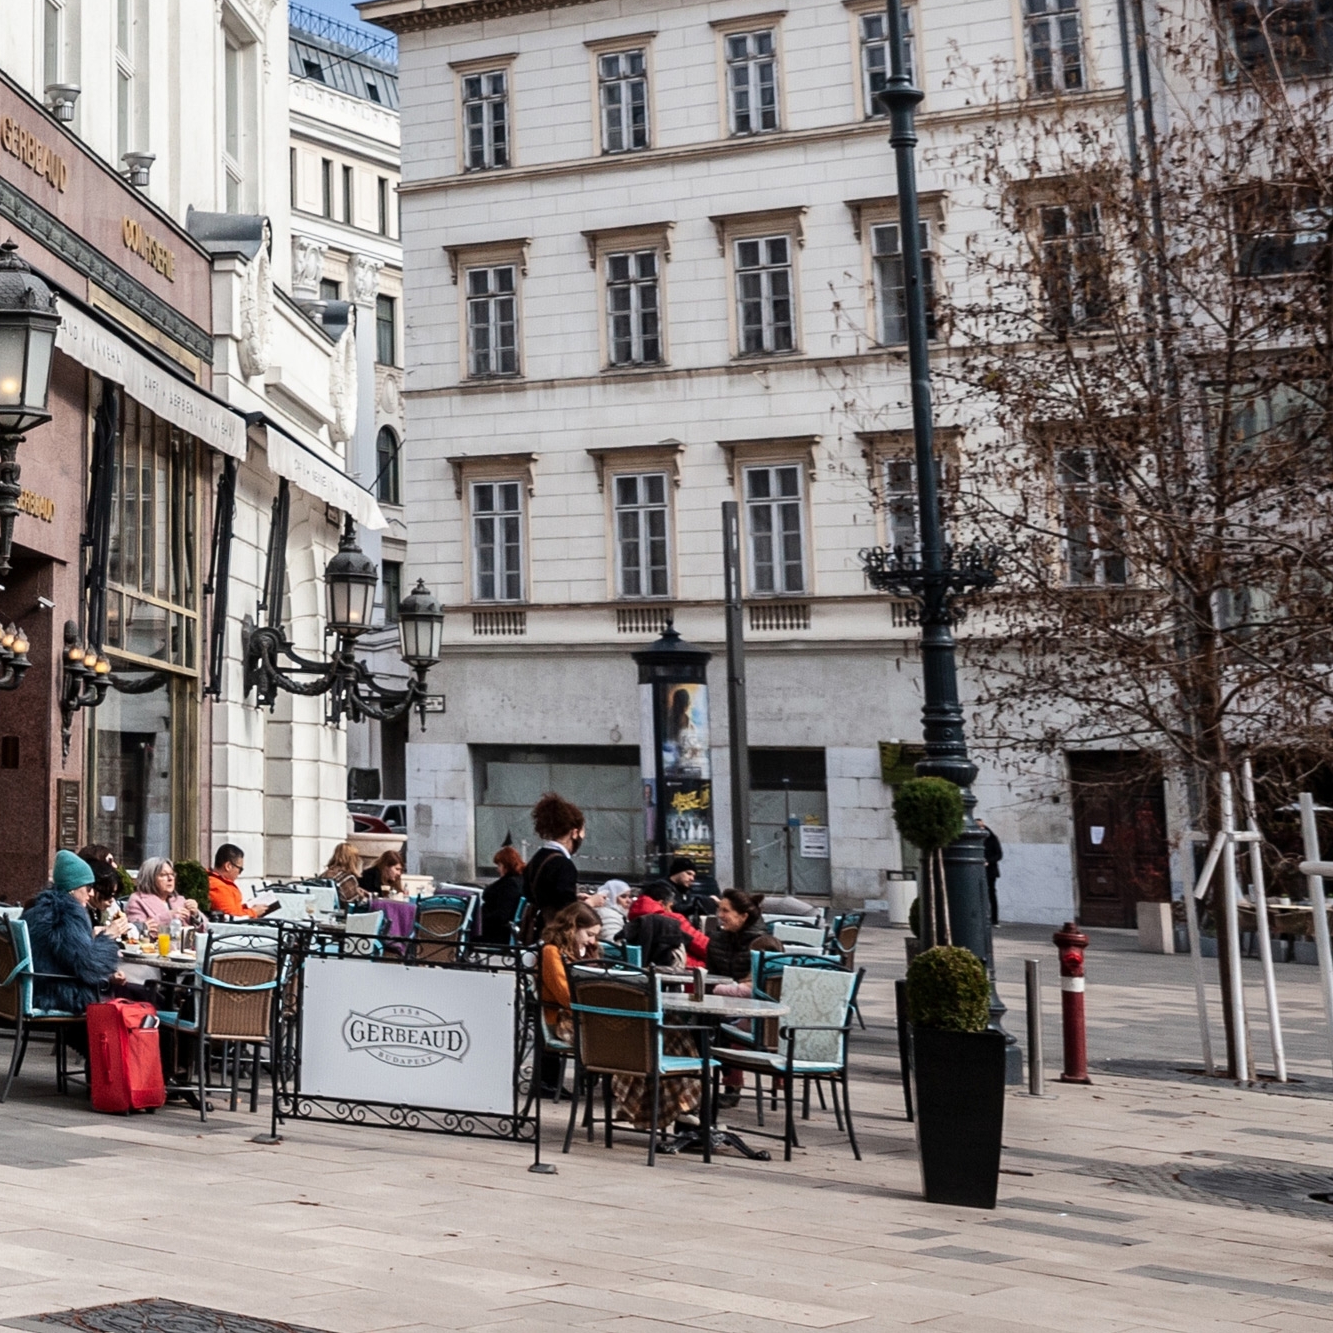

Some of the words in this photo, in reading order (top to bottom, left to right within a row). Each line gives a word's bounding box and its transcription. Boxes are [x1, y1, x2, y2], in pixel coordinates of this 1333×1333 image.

[0, 114, 68, 194] GERBEAUD
[349, 1019, 464, 1052] GERBEAUD
[377, 1050, 434, 1066] BUDAPEST
